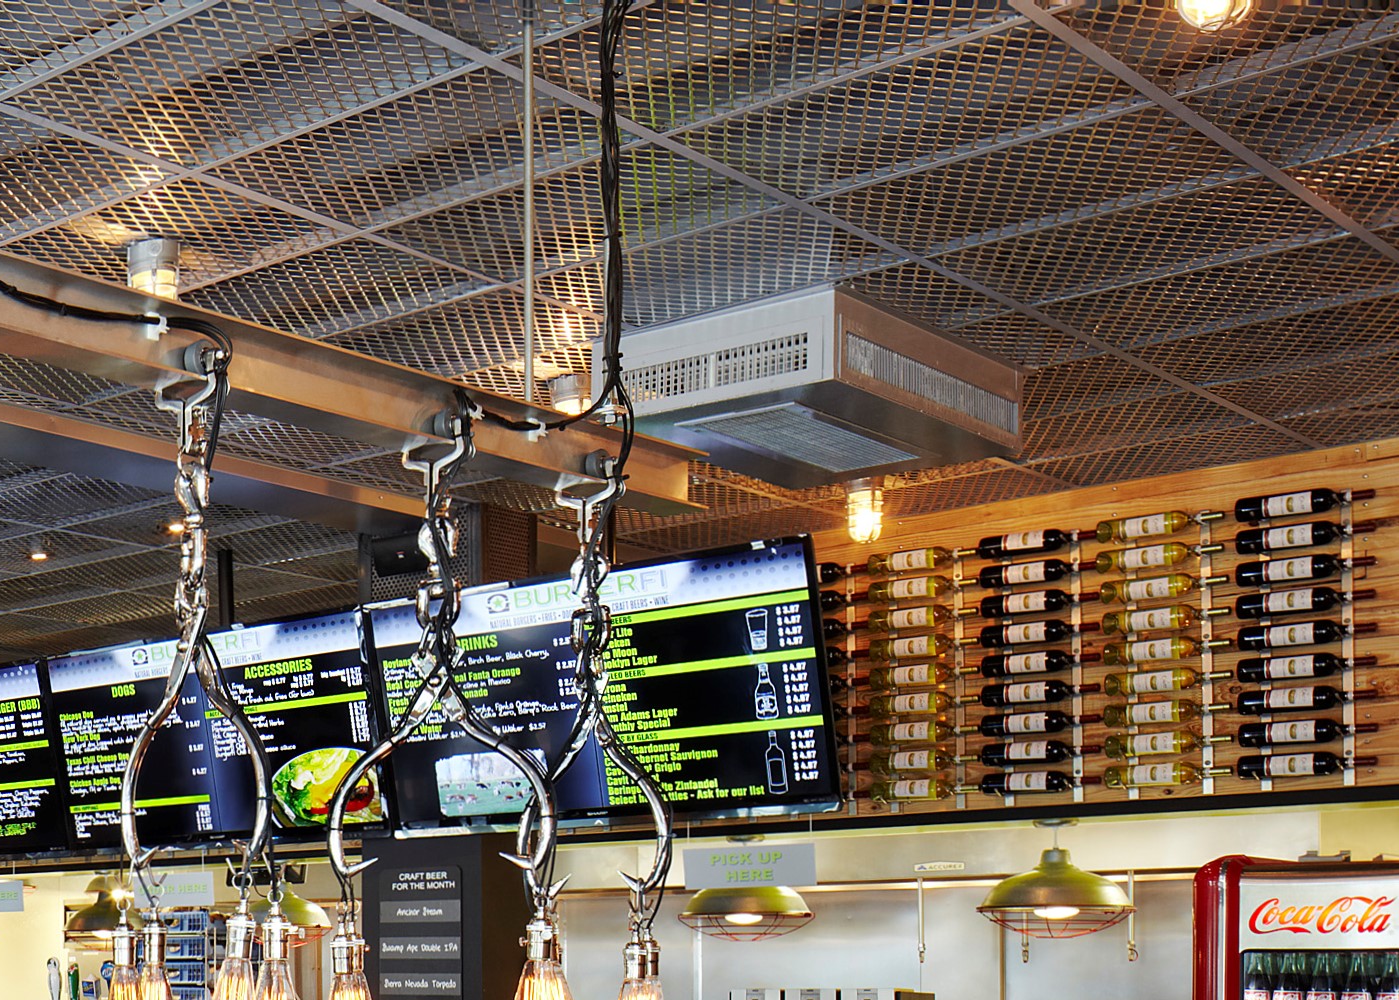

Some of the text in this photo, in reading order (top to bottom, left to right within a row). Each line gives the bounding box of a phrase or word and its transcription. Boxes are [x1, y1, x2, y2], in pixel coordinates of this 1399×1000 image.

[514, 570, 666, 609] BURERFI
[612, 595, 669, 612] CRAFT BEERS WINE
[611, 616, 632, 625] BEERS
[618, 627, 633, 638] Lite
[151, 632, 259, 662] BUERFI
[468, 650, 549, 664] Birch Beer, Black Cherry,
[613, 648, 637, 658] Moon
[632, 655, 658, 666] Lager
[245, 659, 312, 679] ACCESSORIES
[625, 669, 646, 678] BEERS
[468, 668, 521, 681] Fanta Orange
[386, 681, 403, 691] Real
[488, 678, 511, 686] Mexico
[111, 684, 135, 698] DOGS
[601, 692, 637, 702] eineken
[18, 698, 41, 712] (BBB)
[388, 699, 409, 708] Fresh
[516, 700, 542, 709] Orange,
[542, 704, 559, 712] Root
[561, 702, 577, 711] Beer
[60, 711, 94, 720] Chicago Dog
[621, 707, 678, 722] Adams Lager
[420, 725, 442, 733] Water
[501, 725, 524, 733] Water
[637, 718, 670, 730] Special
[63, 735, 75, 743] New
[88, 733, 100, 741] Dog
[637, 732, 658, 741] GLASS
[66, 757, 81, 766] Texas
[97, 754, 117, 762] Cheese
[671, 749, 718, 762] Sauvignon
[654, 763, 681, 773] Grigio
[70, 779, 92, 787] Chicken
[110, 777, 121, 785] Dog
[675, 779, 718, 791] Zinfandel
[609, 786, 765, 805] Select Ask for our list
[710, 851, 782, 866] PICK UP
[399, 872, 447, 881] CRAFT BEER
[726, 869, 774, 882] HERE
[178, 883, 207, 893] HERE
[392, 881, 455, 891] FOR THE MONTH
[397, 907, 443, 916] Anchor Steam
[1249, 896, 1398, 934] Coca-Cola
[382, 943, 458, 953] Swamp Ape Double IPA
[384, 979, 456, 989] Sierra Nevada Torpedo
